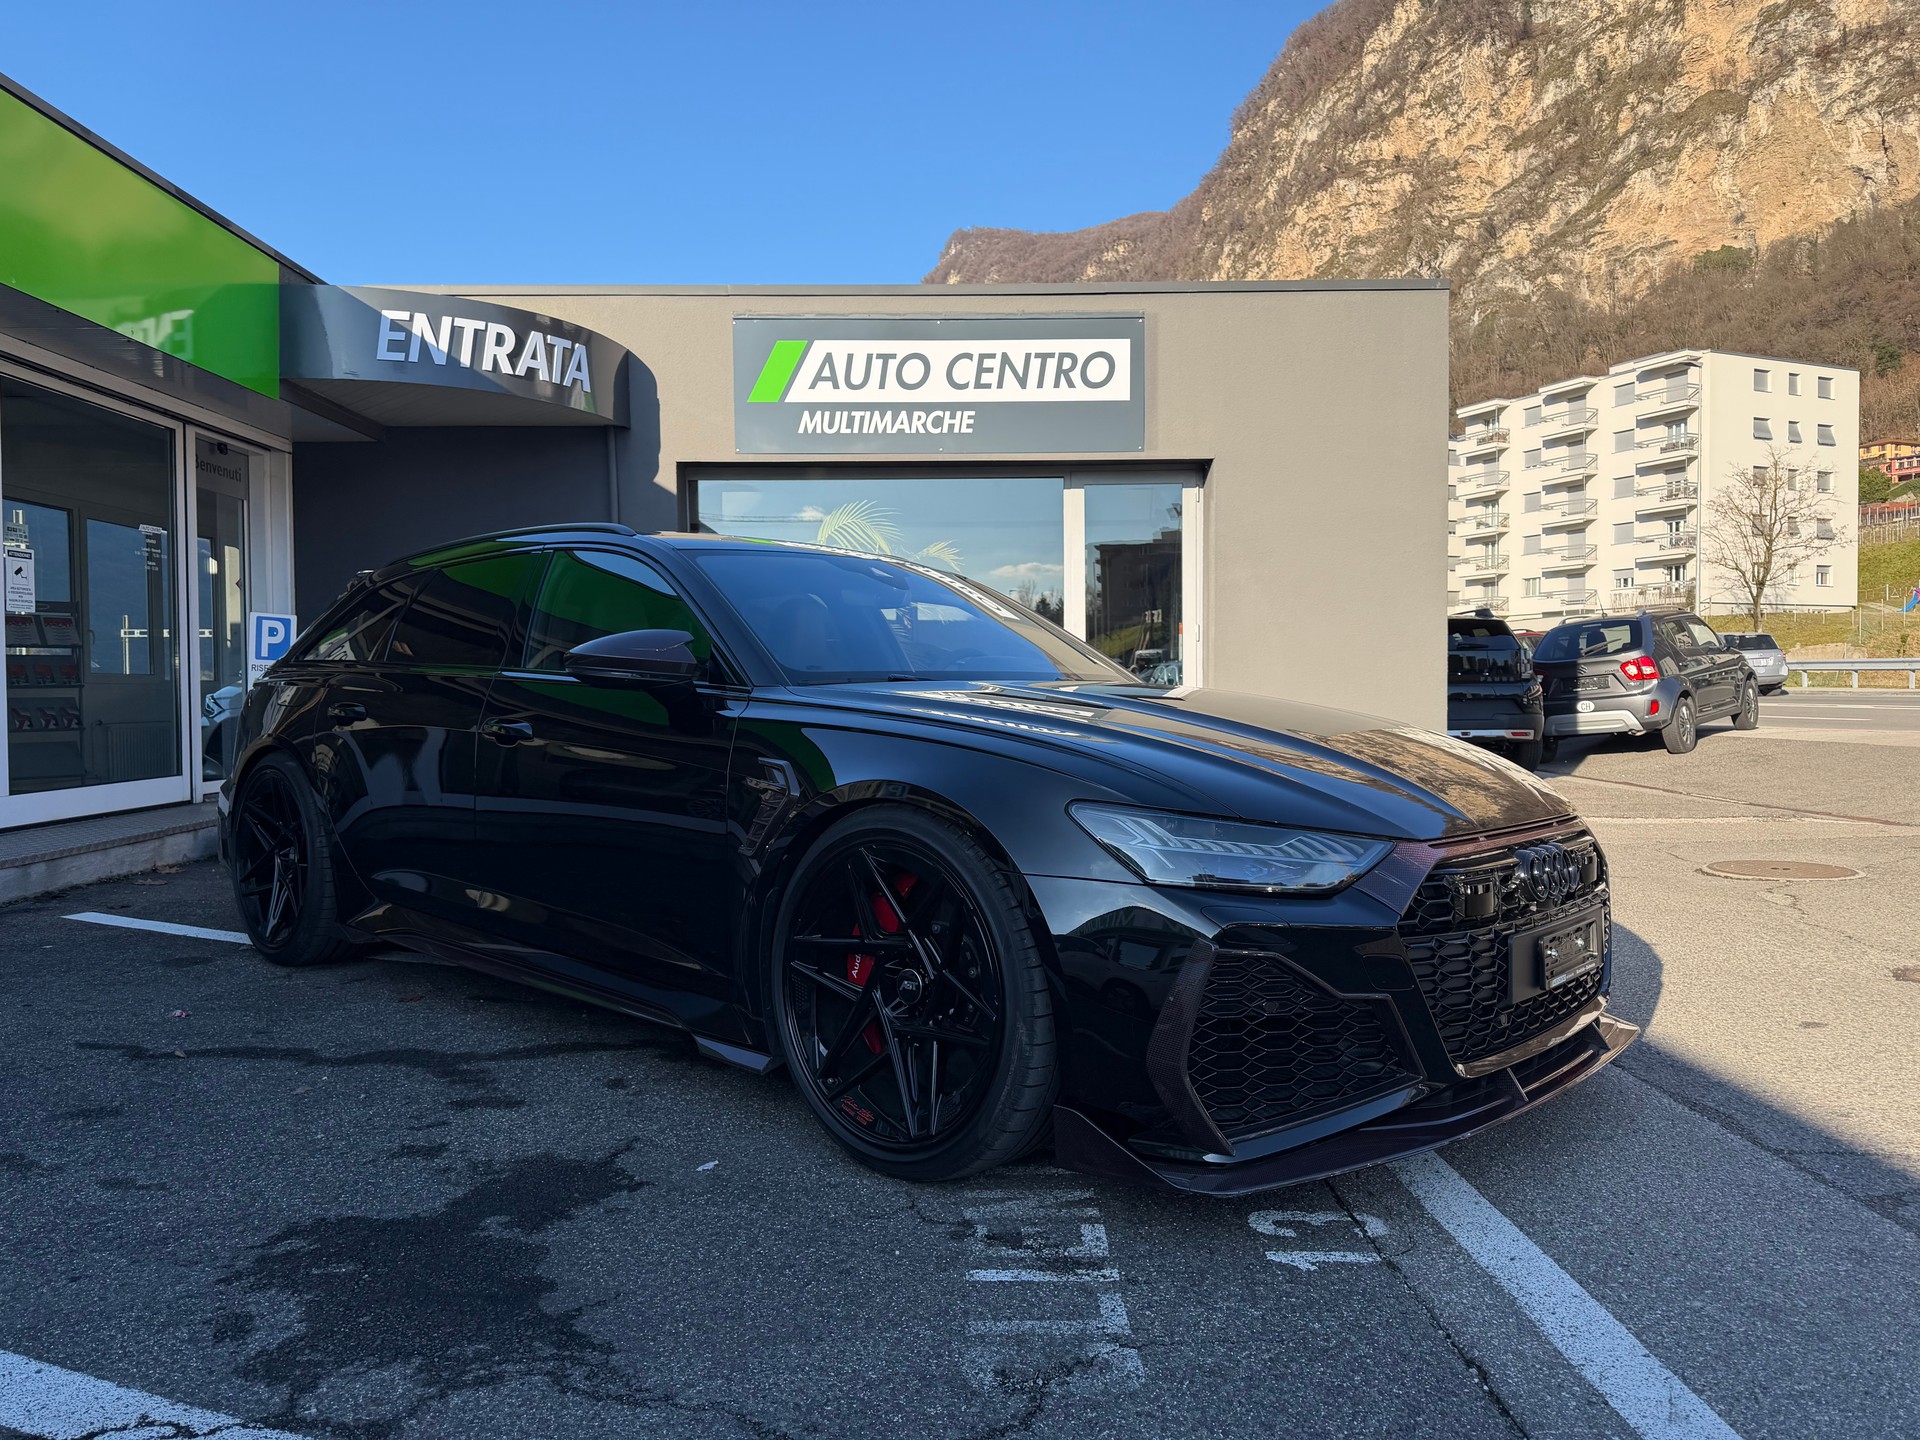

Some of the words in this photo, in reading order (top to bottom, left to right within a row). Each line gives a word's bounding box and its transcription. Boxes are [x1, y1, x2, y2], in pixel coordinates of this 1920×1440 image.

[376, 309, 591, 393] ENTRATA
[808, 351, 931, 391] AUTO
[945, 351, 1116, 390] CENTRO
[797, 410, 976, 434] MULTIMARCHE
[261, 619, 285, 657] P
[251, 664, 270, 672] RISE
[1580, 702, 1591, 711] CH
[1248, 1209, 1390, 1272] 13
